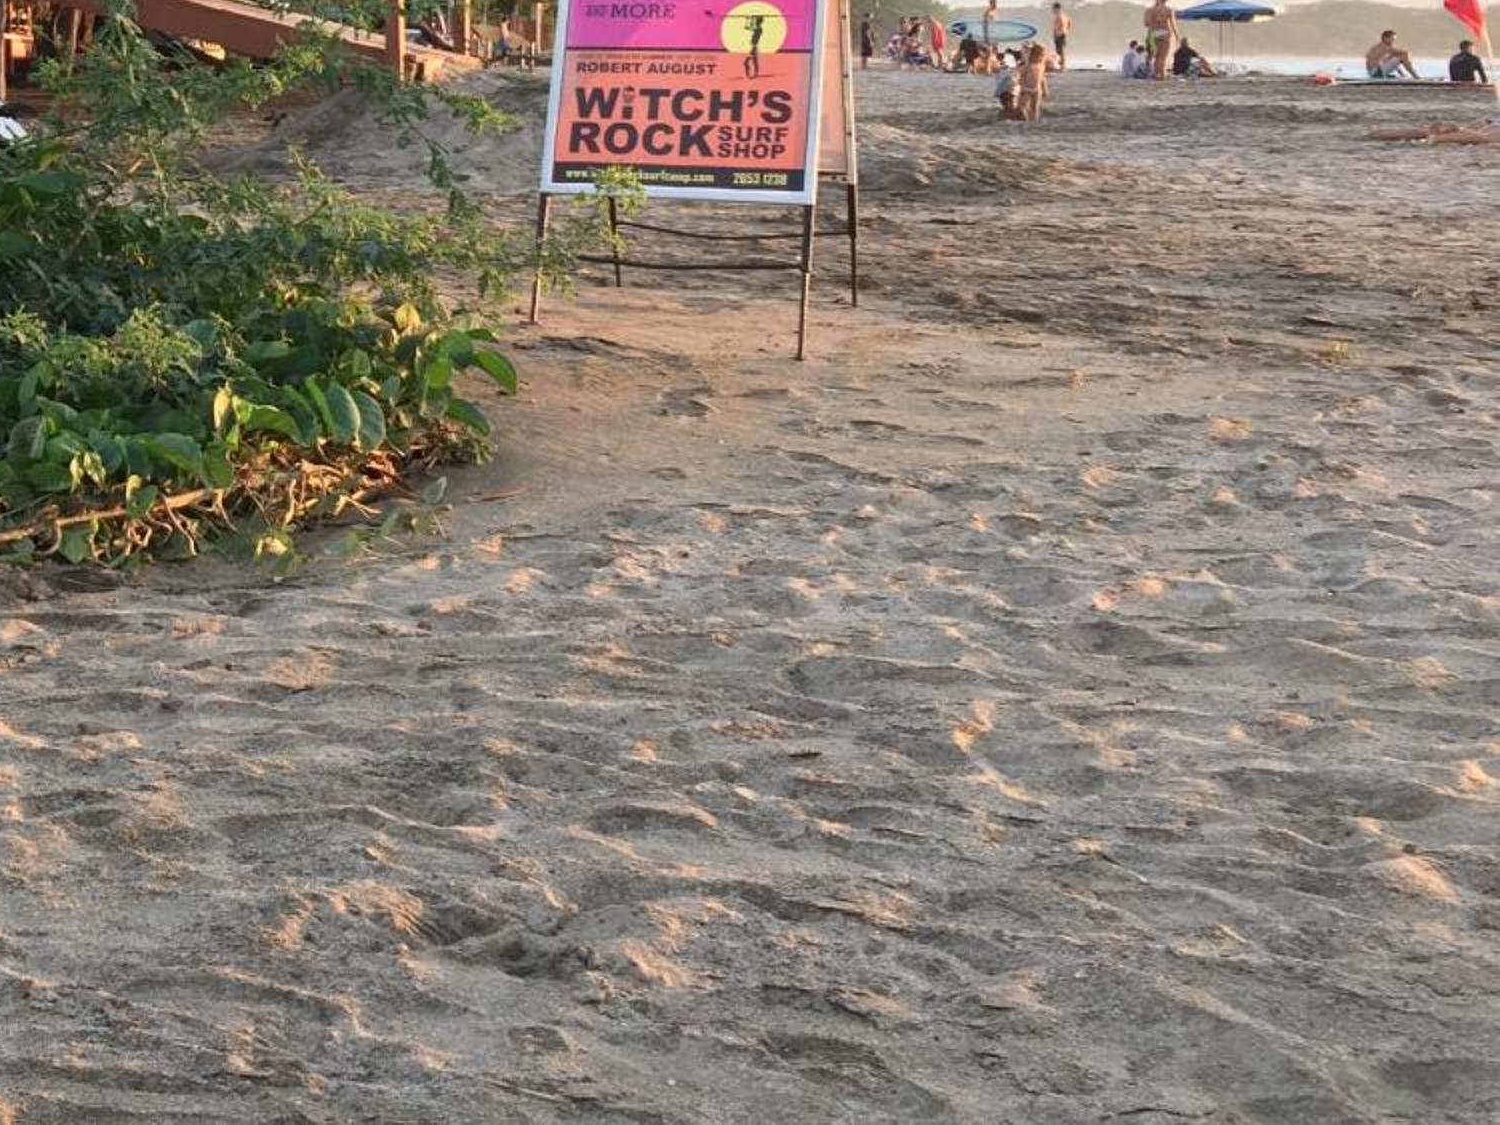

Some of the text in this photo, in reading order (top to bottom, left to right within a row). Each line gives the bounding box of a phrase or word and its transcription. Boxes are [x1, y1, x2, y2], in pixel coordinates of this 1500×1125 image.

[611, 2, 677, 20] MORE
[576, 61, 717, 76] ROBERT AUGUST
[568, 121, 789, 157] ROCK SURF
[717, 142, 786, 160] SHOP
